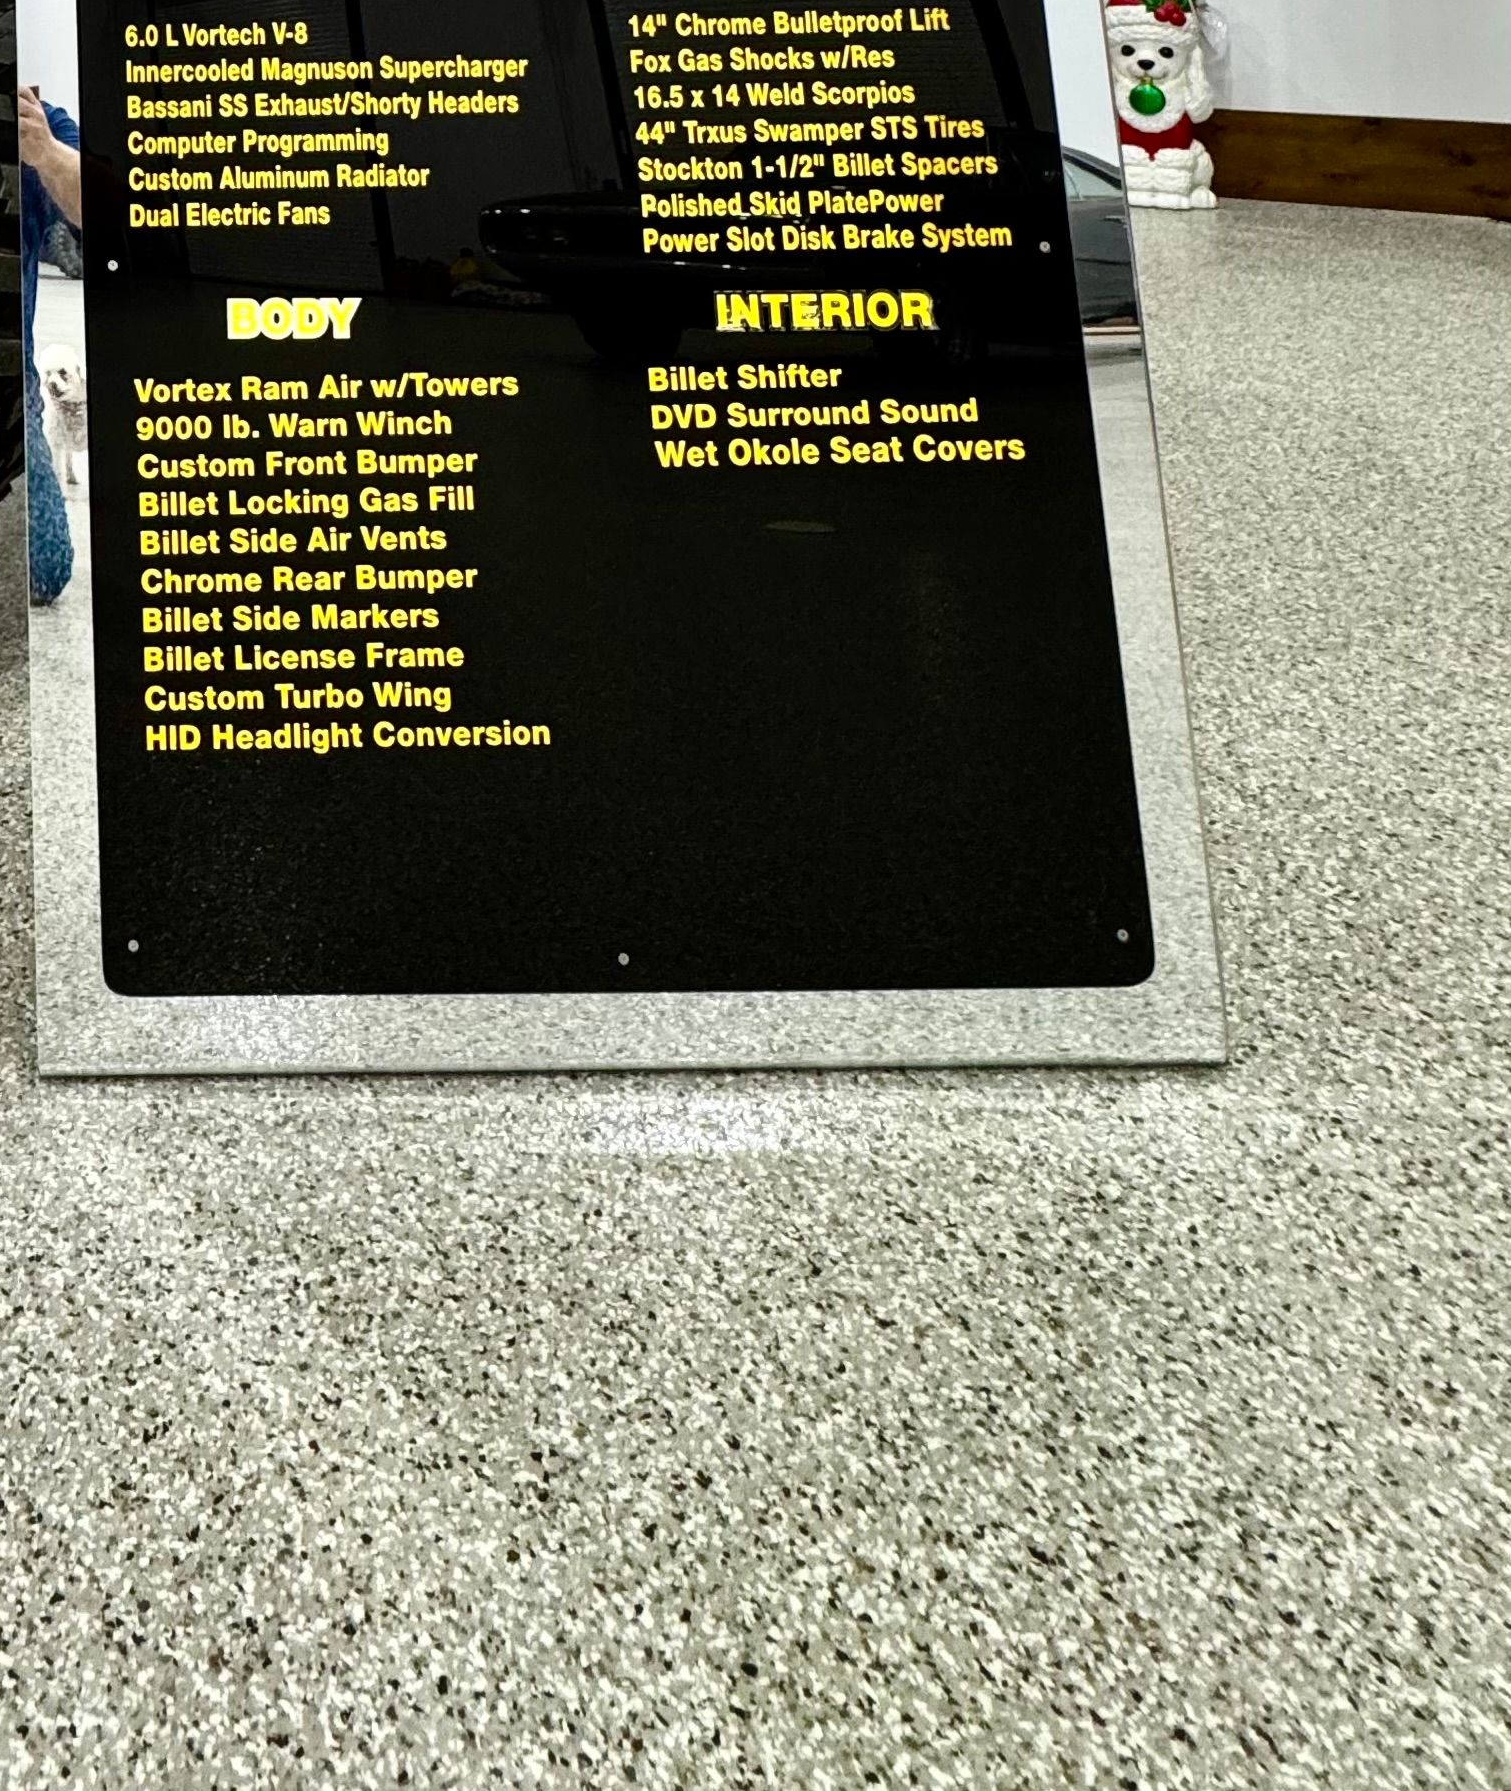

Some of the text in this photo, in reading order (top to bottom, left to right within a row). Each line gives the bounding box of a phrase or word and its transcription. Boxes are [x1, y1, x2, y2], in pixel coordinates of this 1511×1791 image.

[124, 21, 308, 47] 6.0 L Vortech V-8
[628, 7, 948, 38] 14" Chrome Bulletproof Lift
[125, 54, 528, 85] Innercooled Magnuson Supercharger
[629, 44, 895, 73] Fox Gas Shocks w/Res
[126, 90, 519, 119] Bassani SS Exhaust/Shorty Headers
[634, 80, 915, 108] 16.5 x 14 Weld Scorpios
[127, 128, 389, 158] Computer Programming
[635, 114, 984, 145] 44" Trxus Swamper STS Tires
[128, 163, 430, 191] Custom Aluminum Radiator
[638, 151, 998, 181] Stockton 1-1/2" Billet Spacers
[129, 200, 330, 227] Dual Electric Fans
[640, 188, 943, 217] Polished Skid PlatePower
[642, 221, 1012, 253] Power Slot Disk Brake System
[226, 296, 362, 340] BODY
[715, 291, 938, 332] INTERIOR
[133, 371, 519, 403] Vortex Ram Air w/Towers
[647, 363, 841, 391] Billet Shifter
[136, 410, 452, 441] 9000 lb. Warn Winch
[650, 397, 978, 429] DVD Surround Sound
[137, 449, 477, 479] Custom Front Bumper
[654, 433, 1025, 467] Wet Okole Seat Covers
[138, 485, 474, 518] Billet Locking Gas Fill
[140, 526, 447, 555] Billet Side Air Vents
[140, 564, 477, 594] Chrome Rear Bumper
[142, 603, 439, 632] Billet Side Markers
[143, 641, 464, 672] Billet License Frame
[144, 681, 451, 712] Custom Turbo Wing
[145, 720, 550, 754] HID Headlight Conversion
